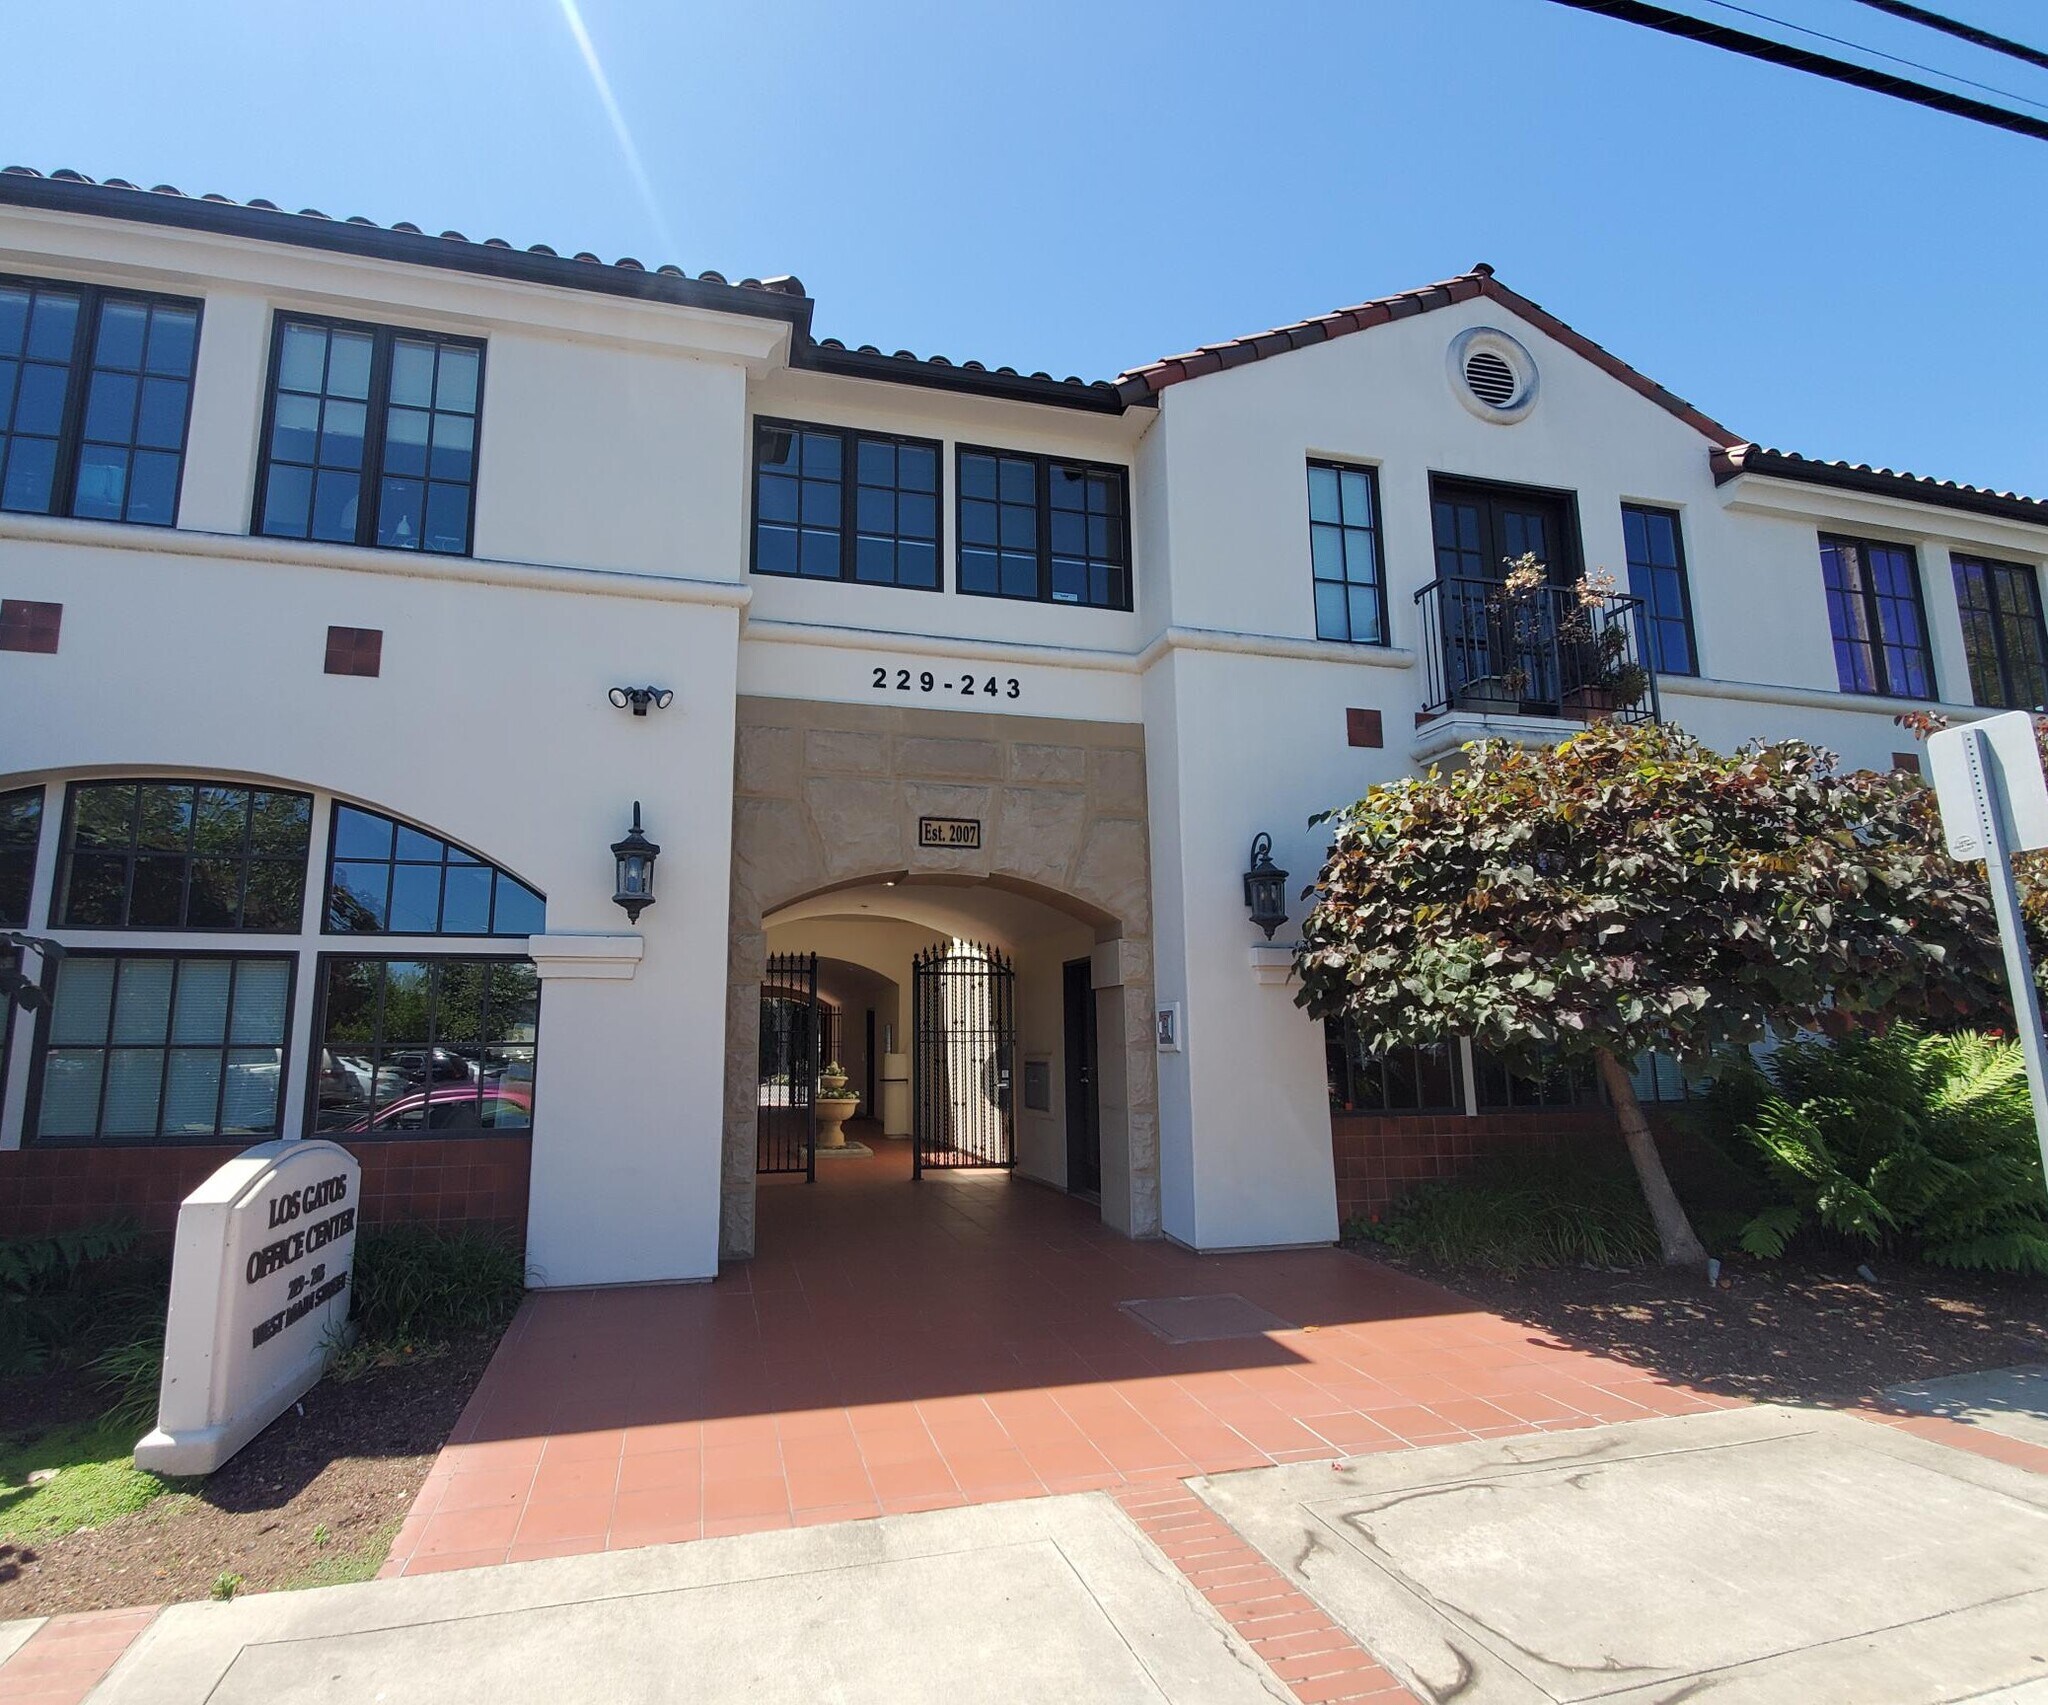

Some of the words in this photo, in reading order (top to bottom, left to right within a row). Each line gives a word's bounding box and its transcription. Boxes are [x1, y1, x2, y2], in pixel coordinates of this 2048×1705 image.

[872, 667, 1021, 699] 229-243
[924, 822, 946, 842] Est.
[949, 825, 977, 843] 2007
[268, 1190, 301, 1230] LOS
[302, 1174, 347, 1214] GATOS
[246, 1230, 306, 1285] OFFICE
[305, 1207, 356, 1254] CENTER
[252, 1309, 287, 1349] WEST
